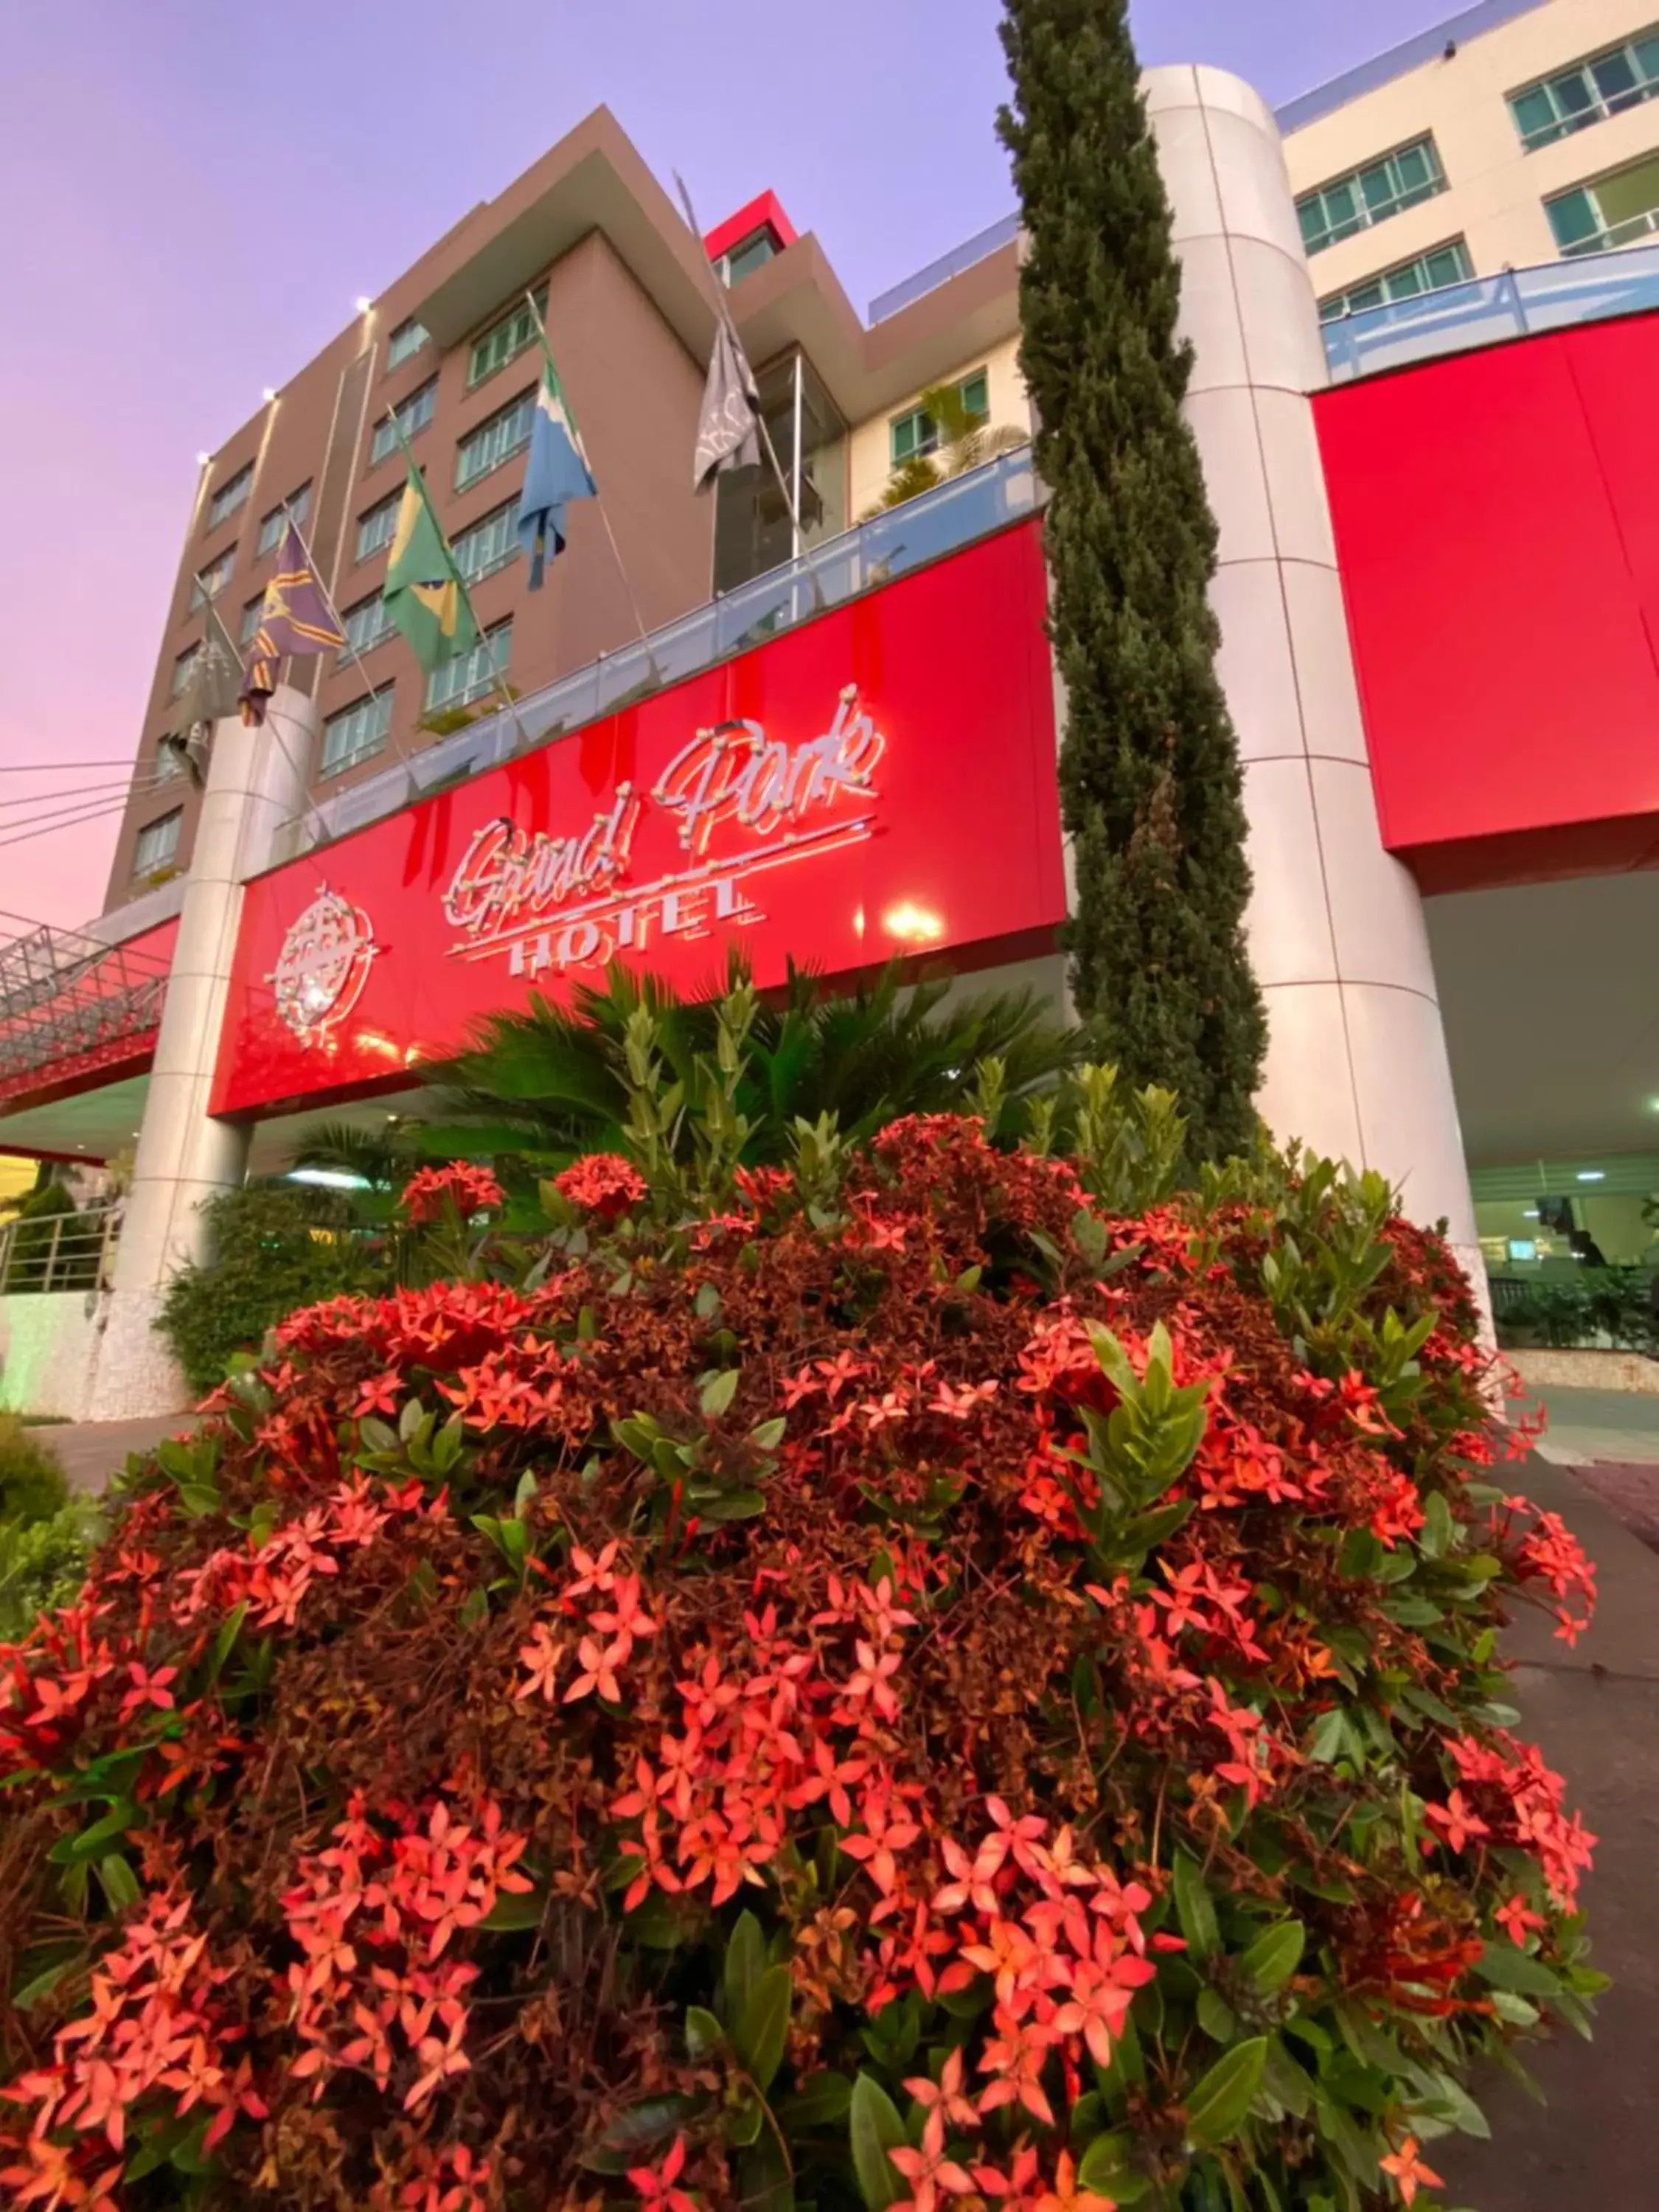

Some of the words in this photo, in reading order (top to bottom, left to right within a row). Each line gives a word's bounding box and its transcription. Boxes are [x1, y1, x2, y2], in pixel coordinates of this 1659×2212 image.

[442, 782, 632, 933] Grand
[652, 683, 873, 850] Park
[509, 878, 756, 976] HOTEL
